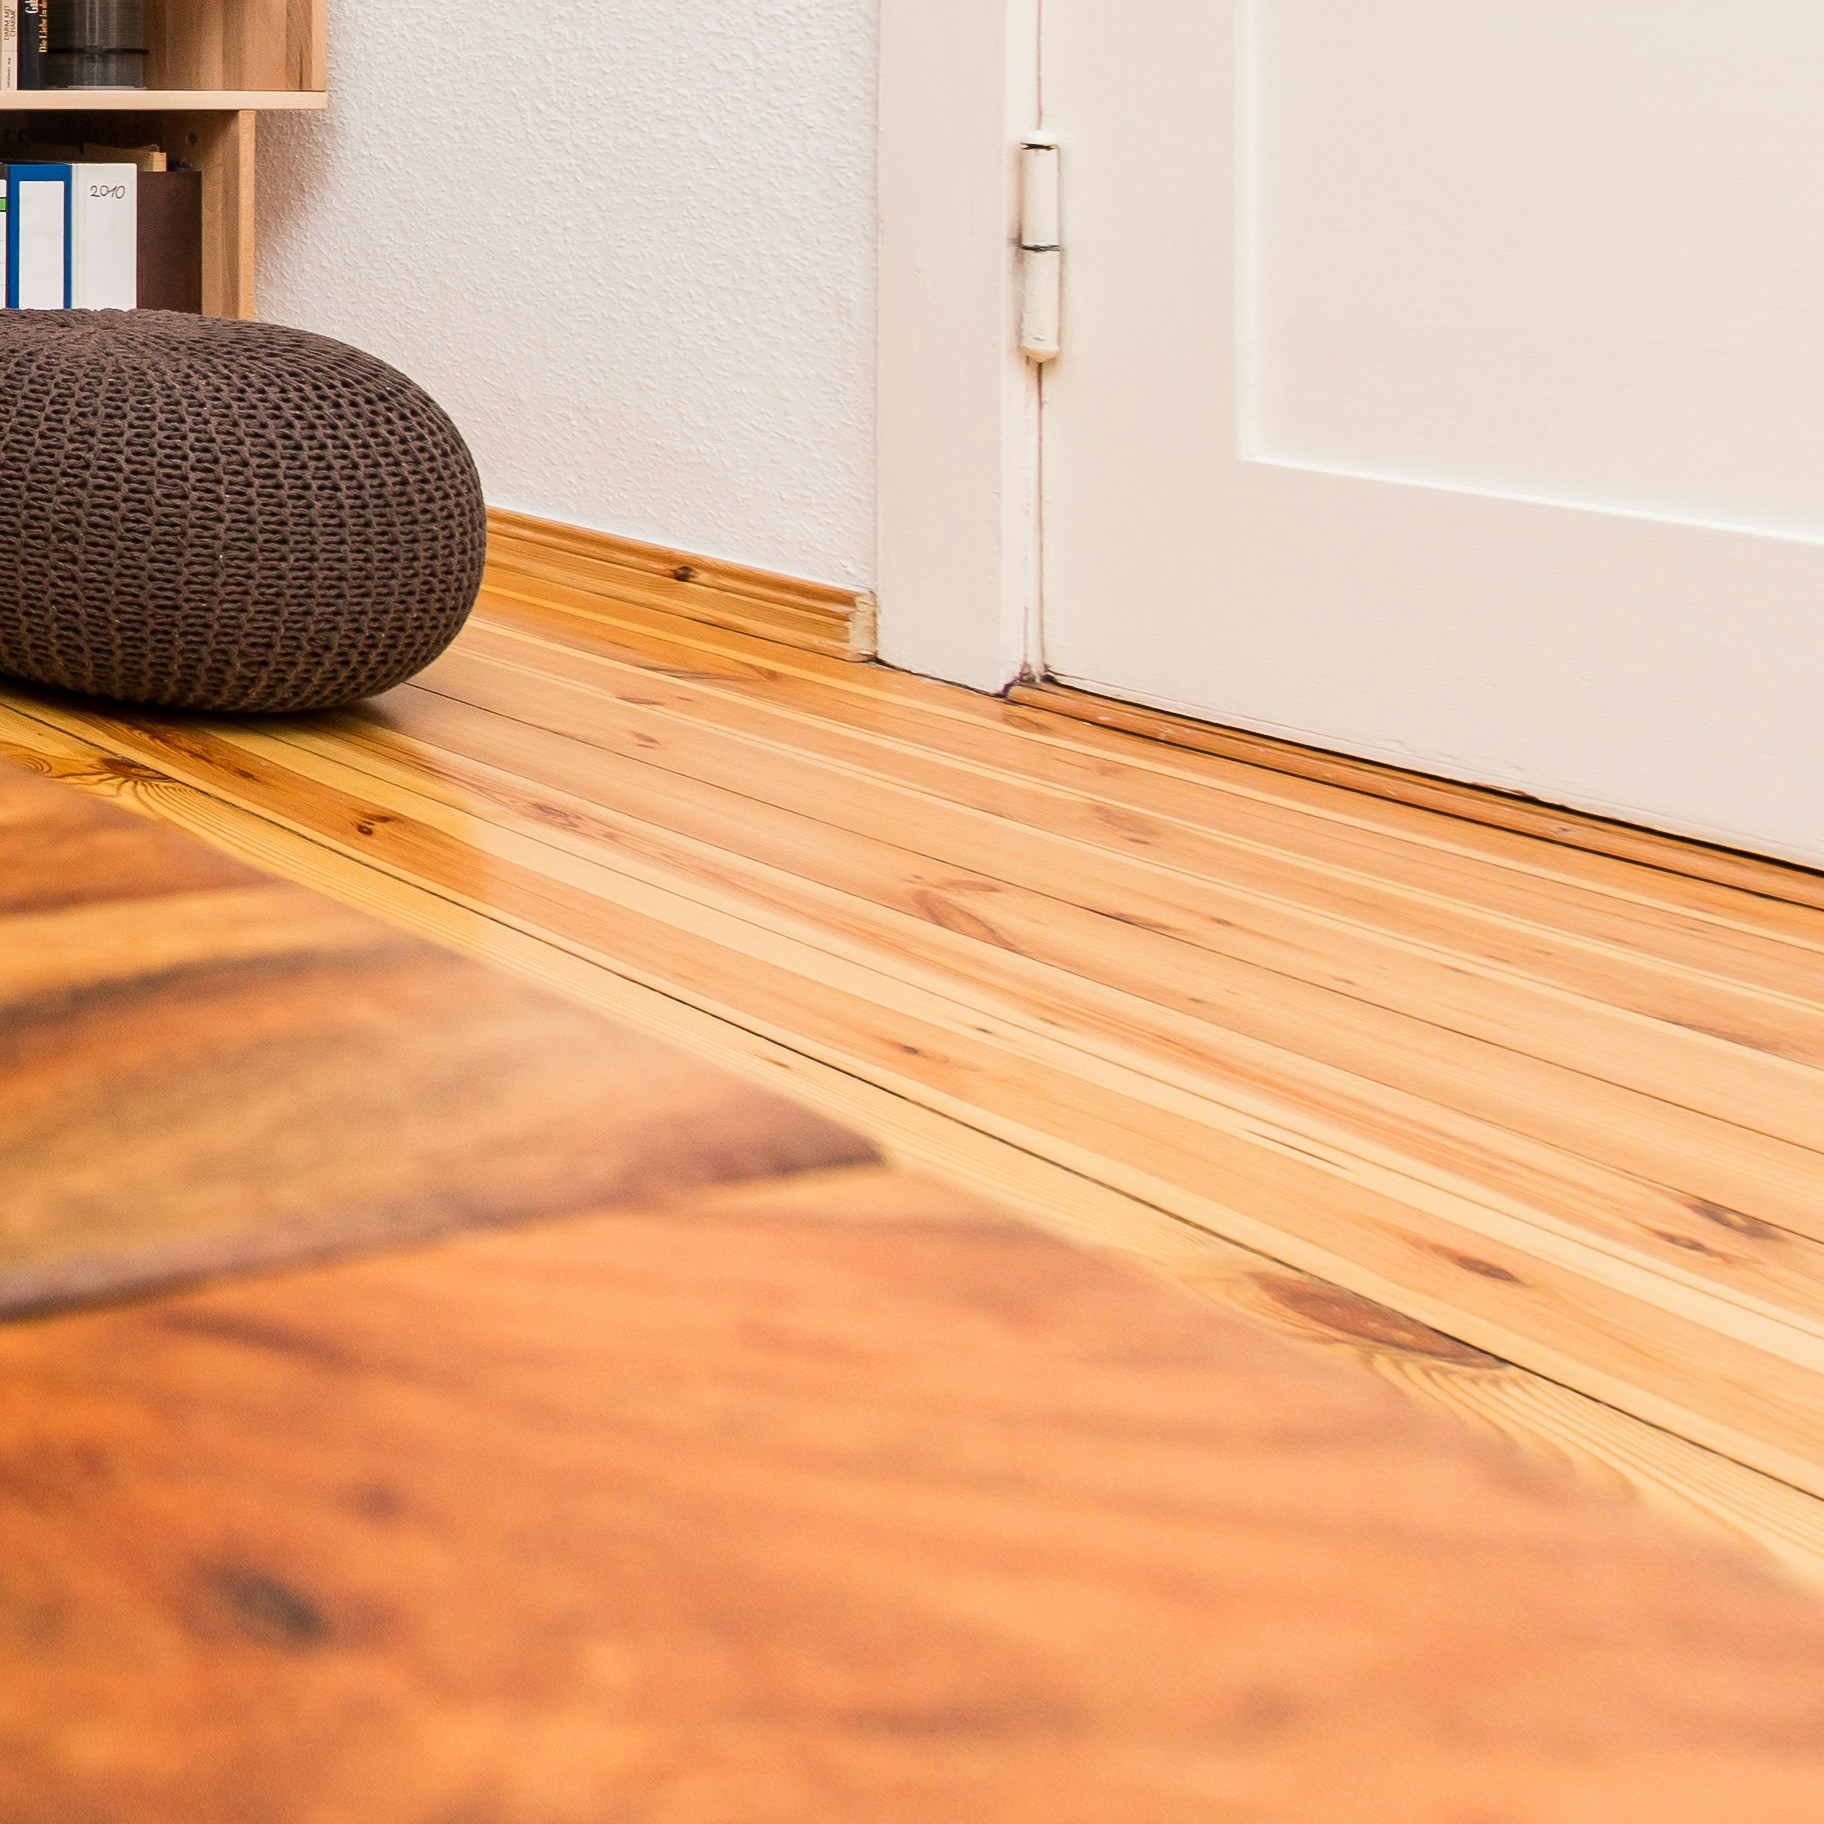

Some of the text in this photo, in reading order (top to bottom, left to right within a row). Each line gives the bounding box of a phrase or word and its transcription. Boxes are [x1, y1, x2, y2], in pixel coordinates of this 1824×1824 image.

[38, 18, 48, 39] Liebe
[38, 39, 48, 53] Die
[89, 184, 126, 200] 2010
